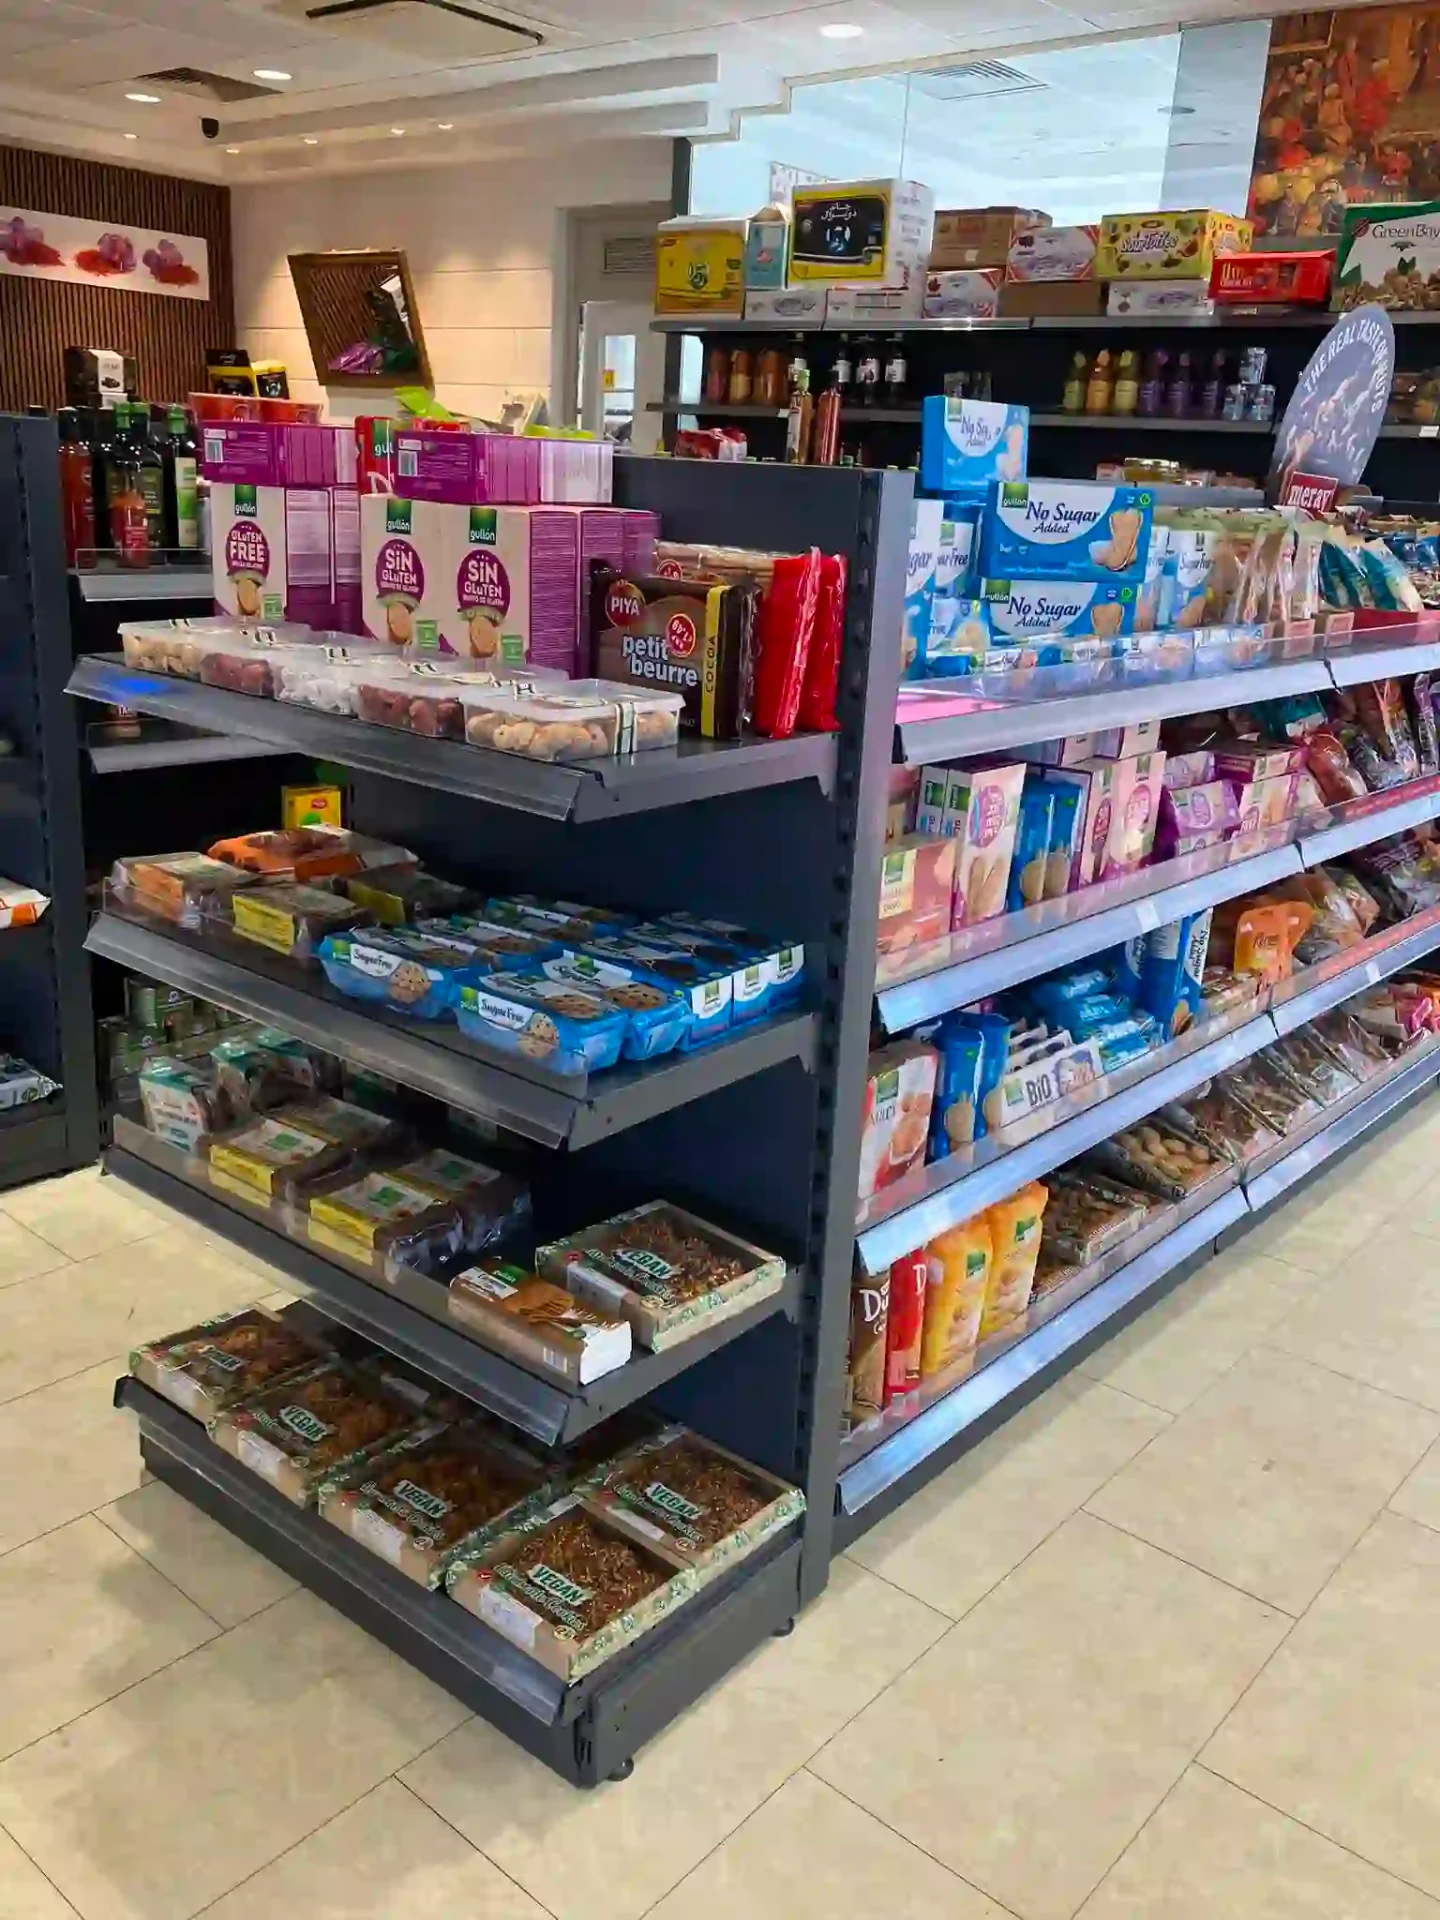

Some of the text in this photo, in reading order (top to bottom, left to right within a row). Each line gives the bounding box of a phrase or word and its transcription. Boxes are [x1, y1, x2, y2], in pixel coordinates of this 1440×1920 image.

[1303, 353, 1327, 393] THE
[1328, 321, 1356, 363] REAL
[1025, 500, 1100, 525] No Sugar
[470, 528, 495, 541] gullón
[1032, 522, 1070, 534] Added
[229, 540, 265, 563] FREE
[610, 596, 640, 616] PIYA
[1007, 595, 1082, 621] No Sugar
[1014, 617, 1051, 628] Added
[622, 634, 669, 661] petit
[630, 653, 699, 687] beurre
[706, 636, 716, 694] COCOA
[397, 1482, 445, 1516] VEGAN
[651, 1483, 701, 1518] VEGAN
[532, 1565, 584, 1603] VEGAN
